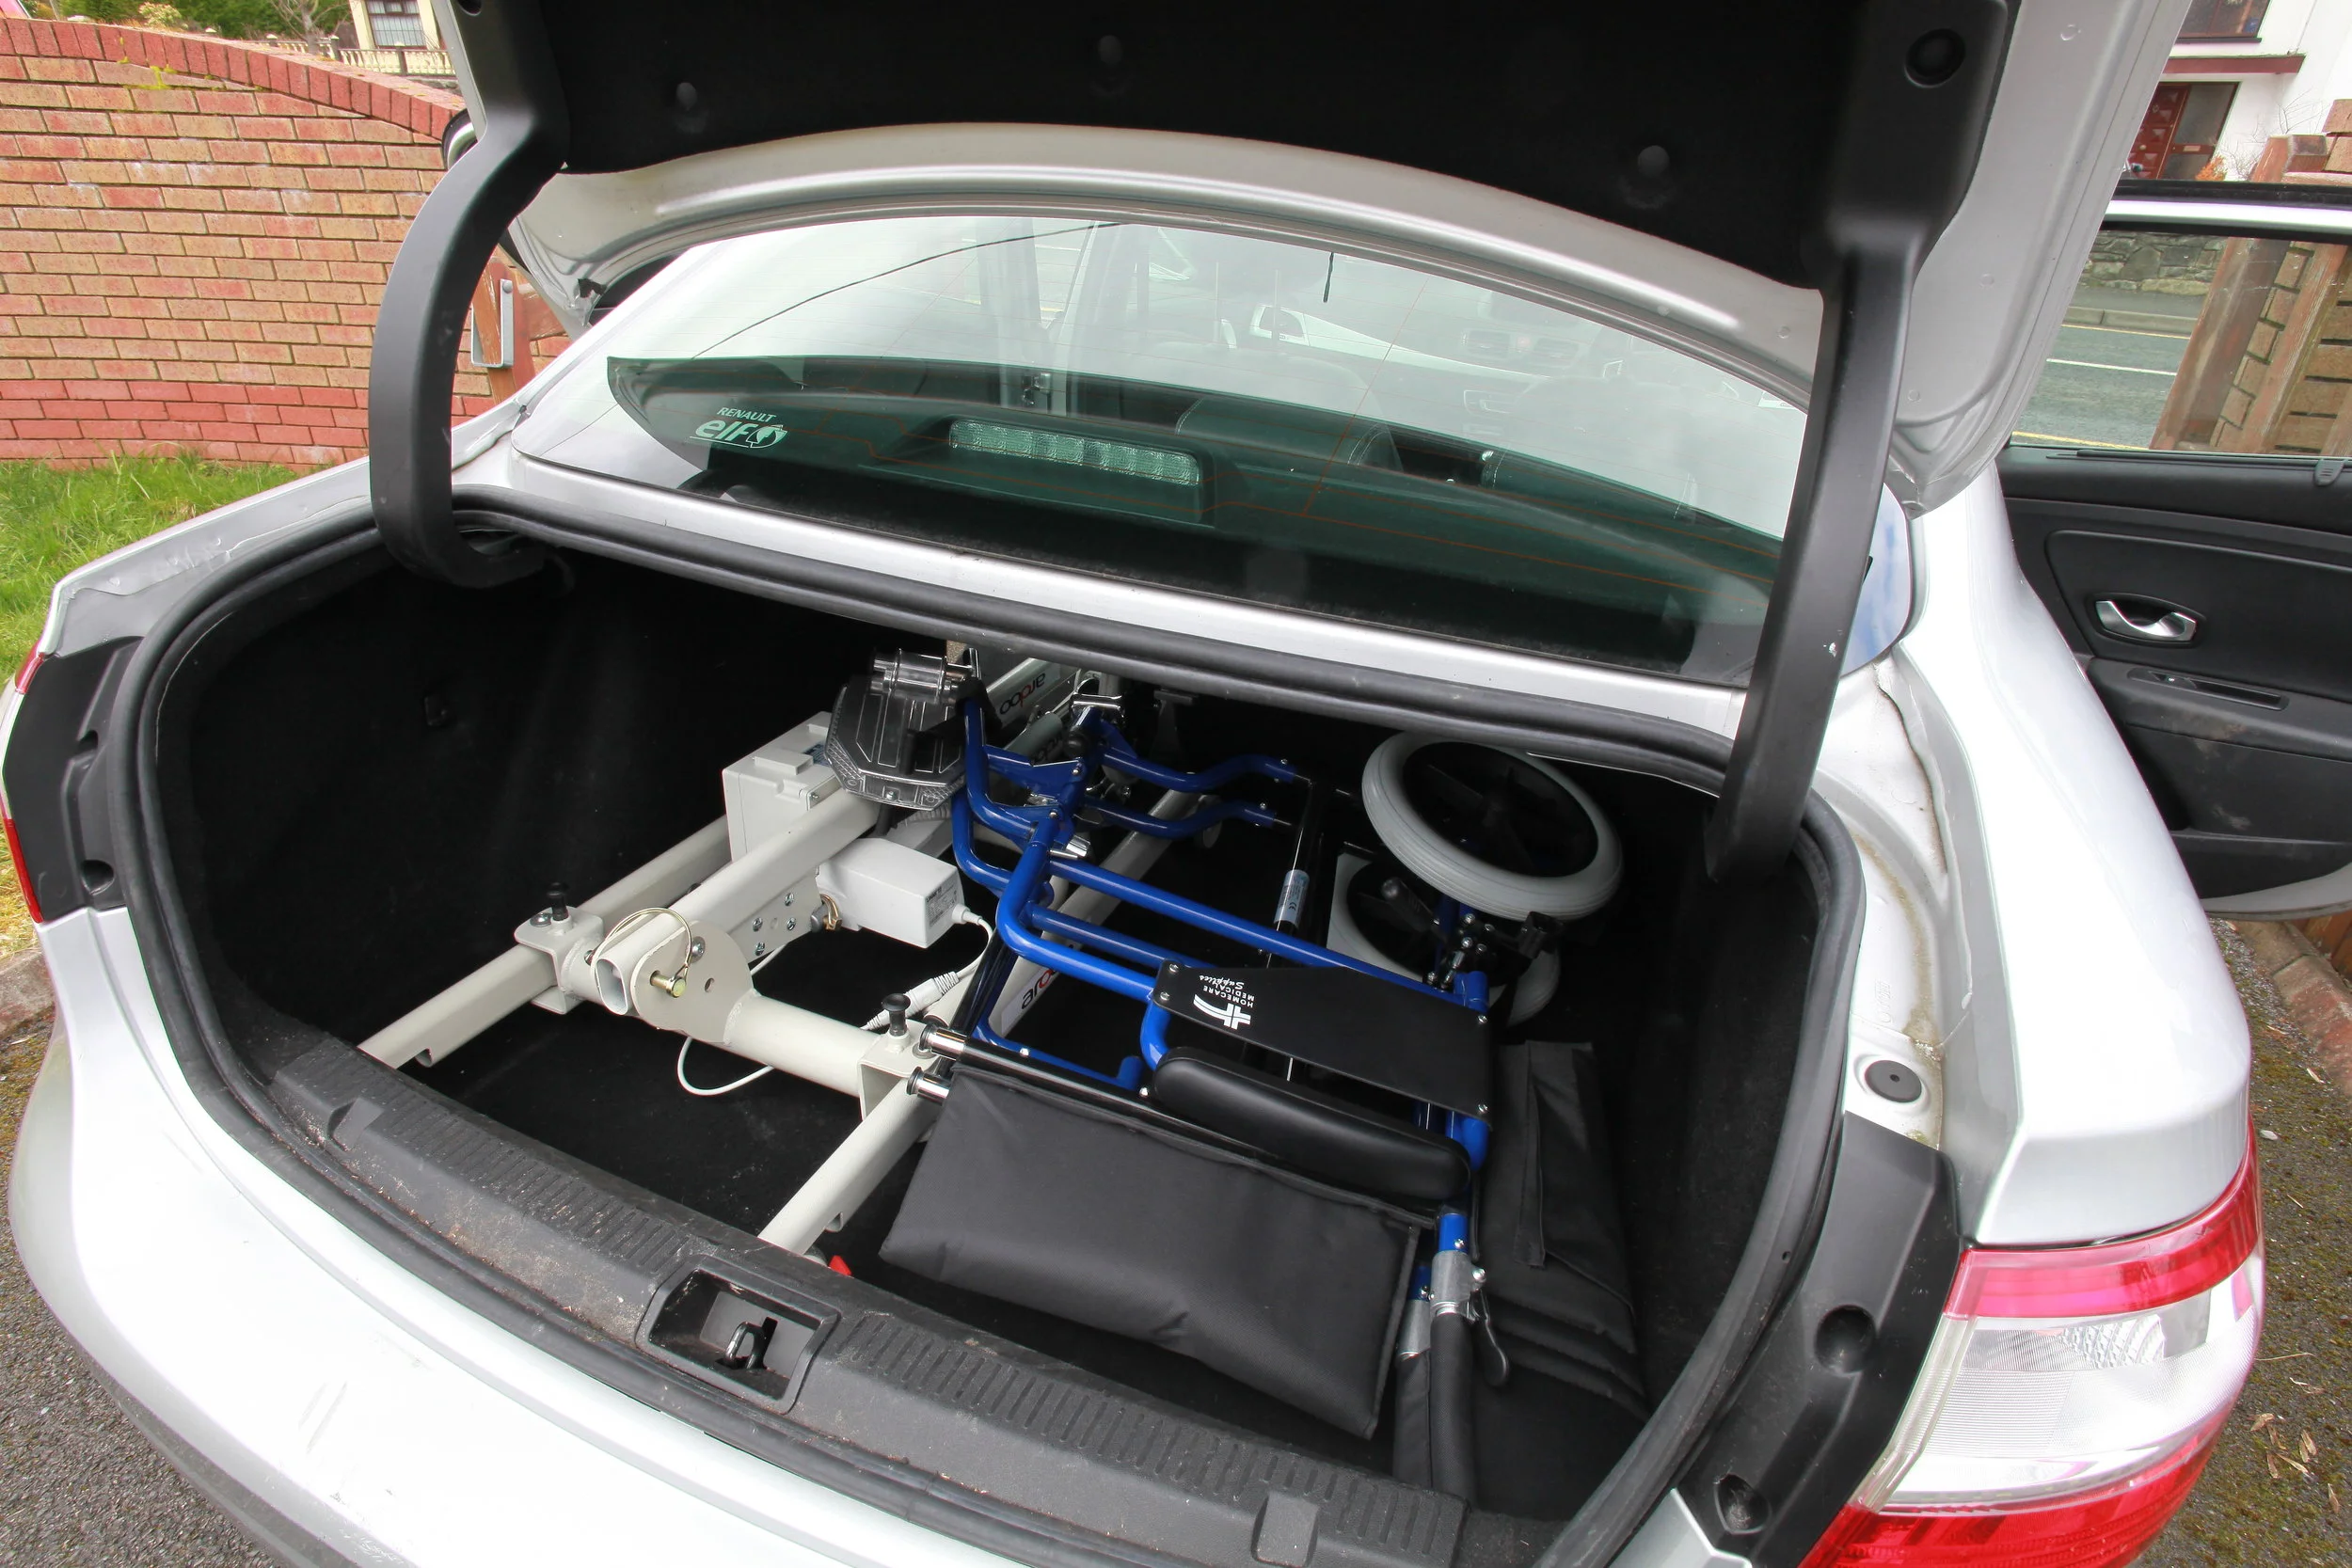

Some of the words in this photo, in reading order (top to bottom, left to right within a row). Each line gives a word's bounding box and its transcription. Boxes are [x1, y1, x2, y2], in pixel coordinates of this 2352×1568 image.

[717, 407, 777, 422] RENAULT
[695, 420, 759, 441] elf
[1200, 974, 1245, 990] Supplies
[1213, 982, 1255, 1002] MEDICAL
[1202, 985, 1254, 1008] HOMECARE
